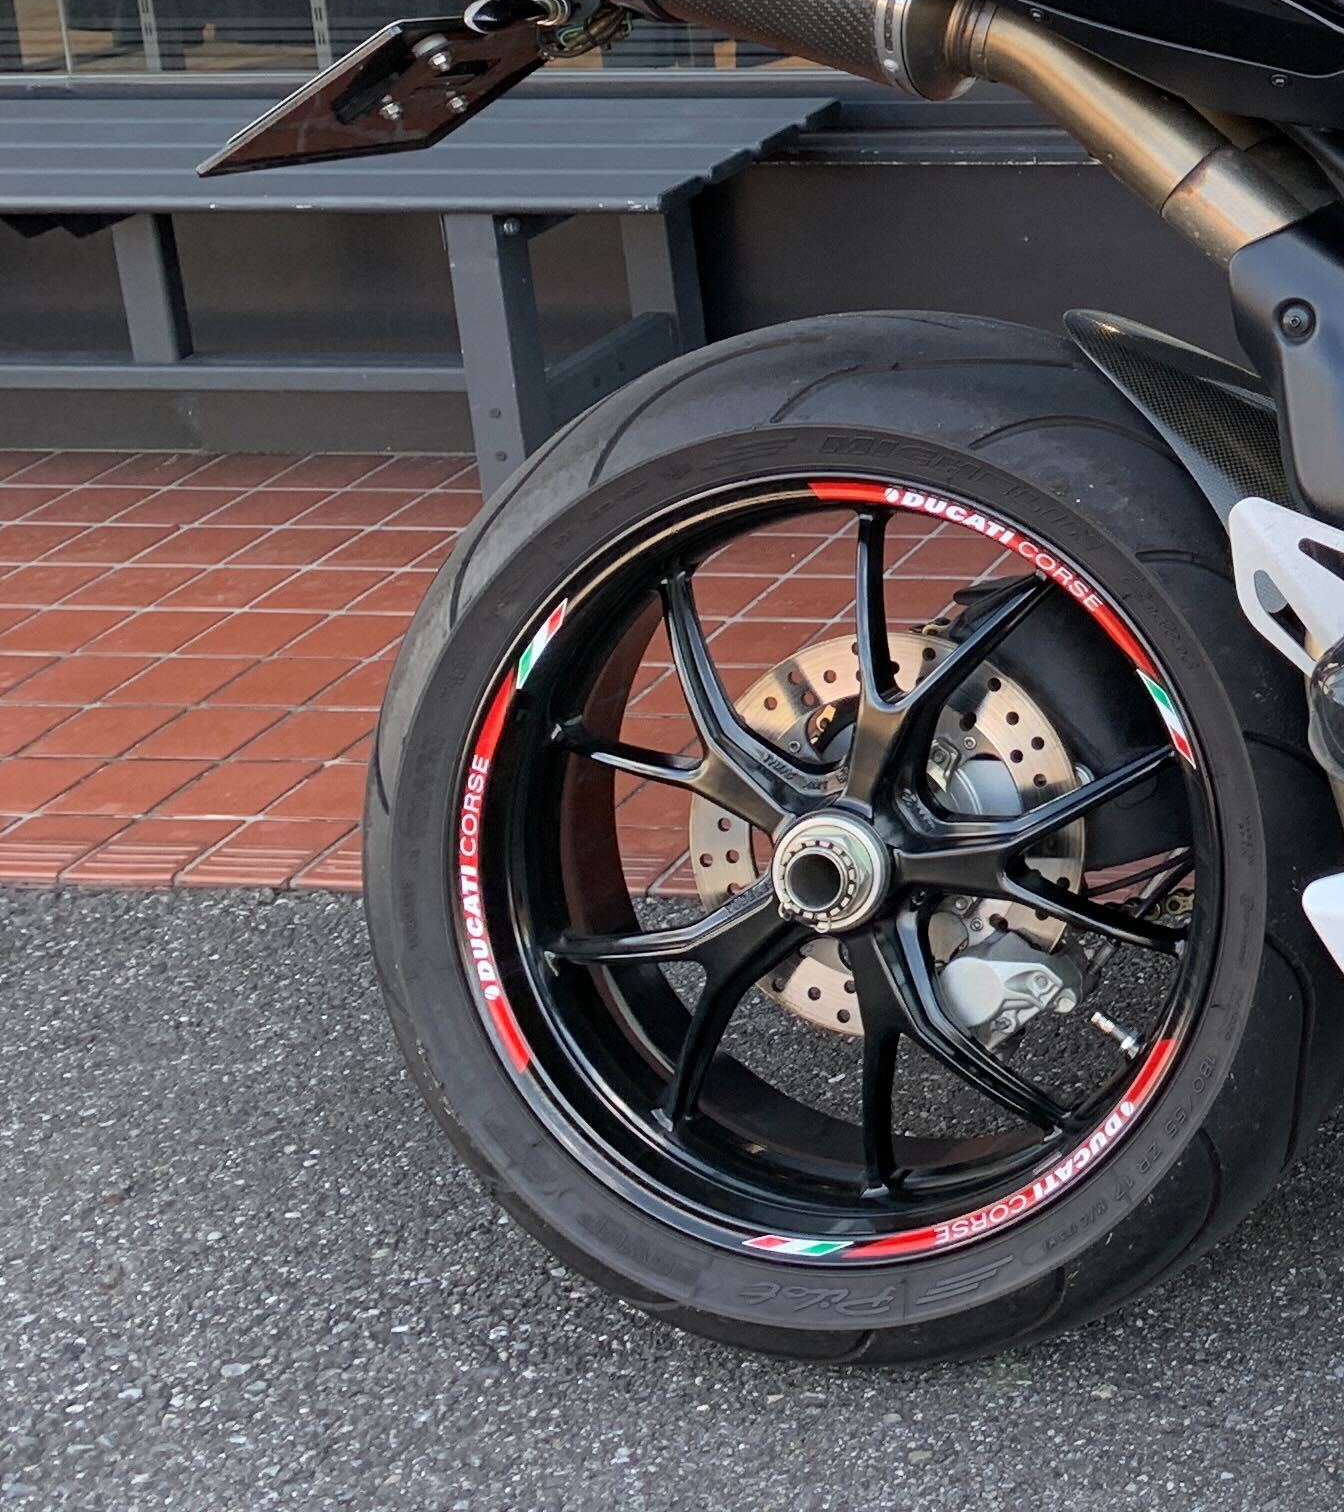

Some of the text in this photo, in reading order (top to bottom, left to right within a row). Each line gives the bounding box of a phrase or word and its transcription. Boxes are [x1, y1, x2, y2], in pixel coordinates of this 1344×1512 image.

[901, 491, 1104, 612] DUCATI CORSE
[459, 753, 496, 982] DUCATI CORSE
[935, 1111, 1128, 1245] DUCATI CORSE
